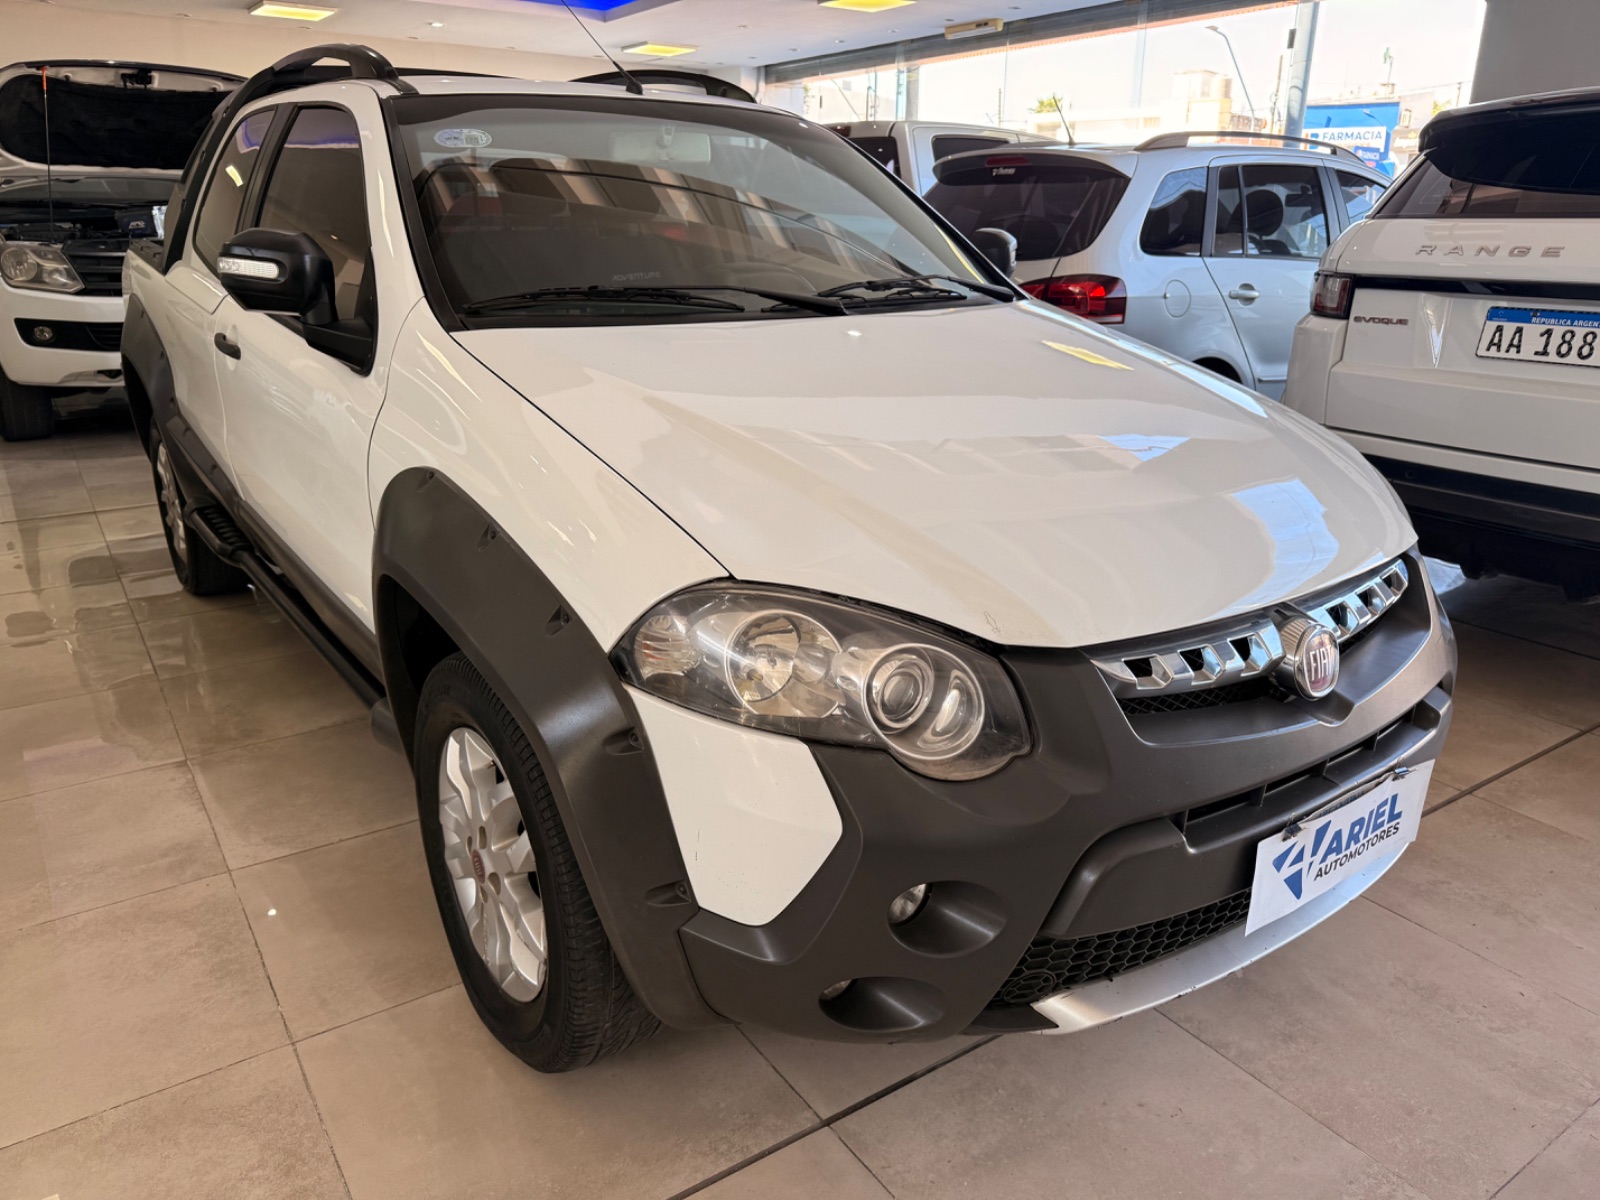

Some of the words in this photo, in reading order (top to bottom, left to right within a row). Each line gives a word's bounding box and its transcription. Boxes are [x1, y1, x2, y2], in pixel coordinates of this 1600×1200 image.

[1322, 131, 1382, 140] FARMACIA
[1415, 244, 1566, 258] RANGE
[1353, 315, 1409, 326] EVOQUE
[1531, 316, 1571, 326] REPUBLICA
[1572, 319, 1600, 328] ARGEN
[1485, 324, 1524, 354] AA
[1533, 328, 1598, 360] 188
[1309, 644, 1332, 681] FIAT
[1319, 793, 1403, 865] ARIEL
[1313, 821, 1400, 881] AUTOMOTORES
